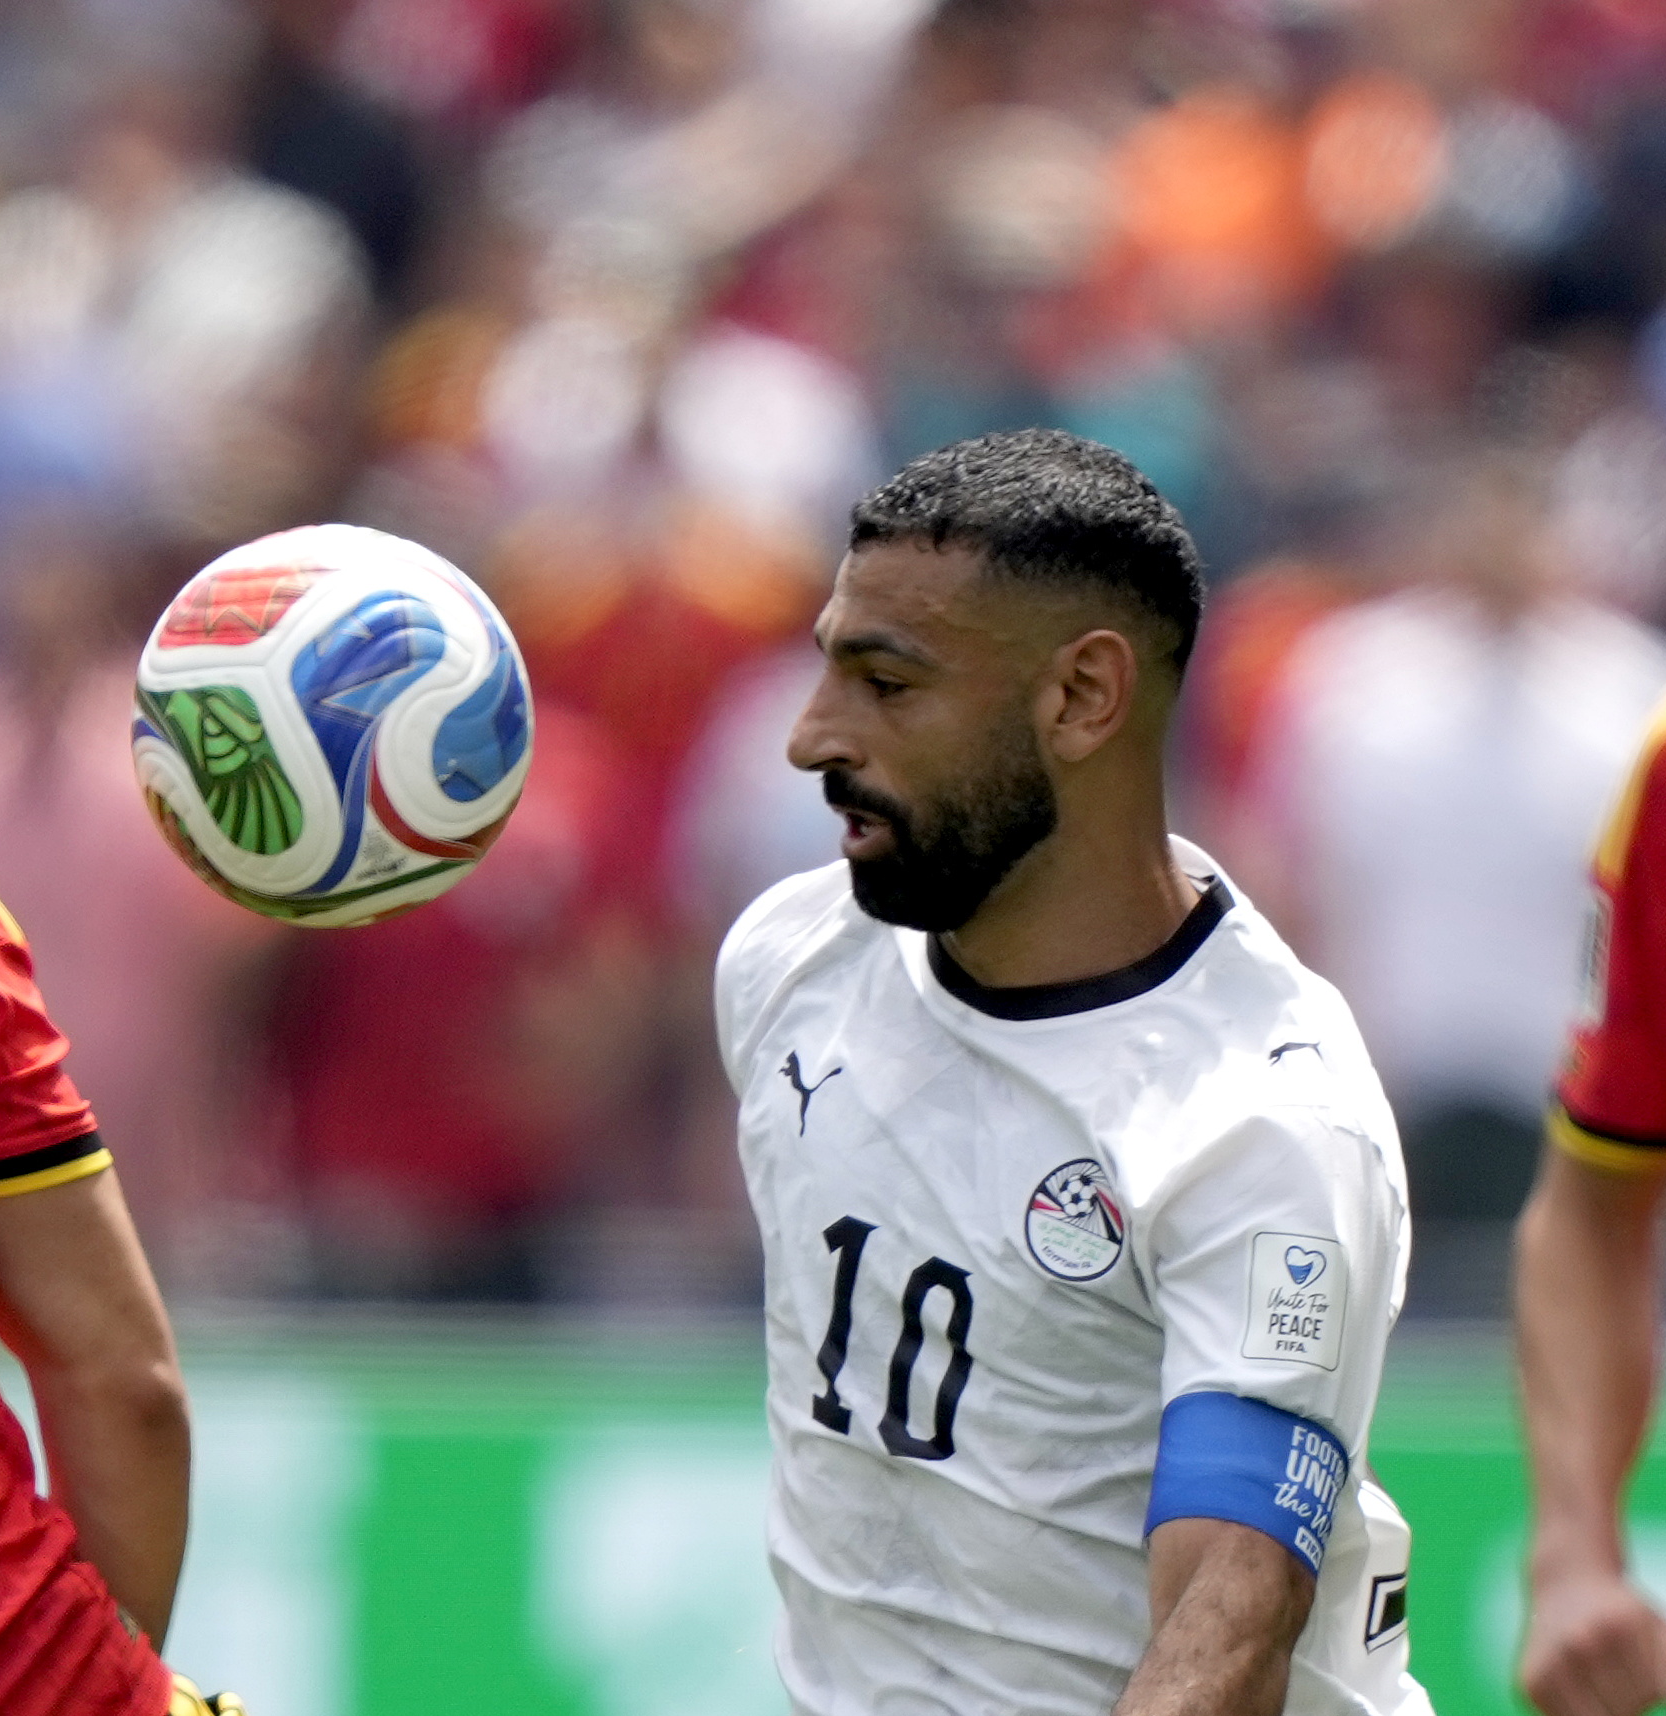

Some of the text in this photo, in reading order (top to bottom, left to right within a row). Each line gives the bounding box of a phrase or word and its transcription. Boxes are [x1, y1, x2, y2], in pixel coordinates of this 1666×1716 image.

[1267, 1286, 1330, 1314] Unite For
[812, 1215, 973, 1460] 10
[1268, 1313, 1324, 1340] PEACE
[1275, 1340, 1307, 1353] FIFA
[1274, 1481, 1312, 1517] the
